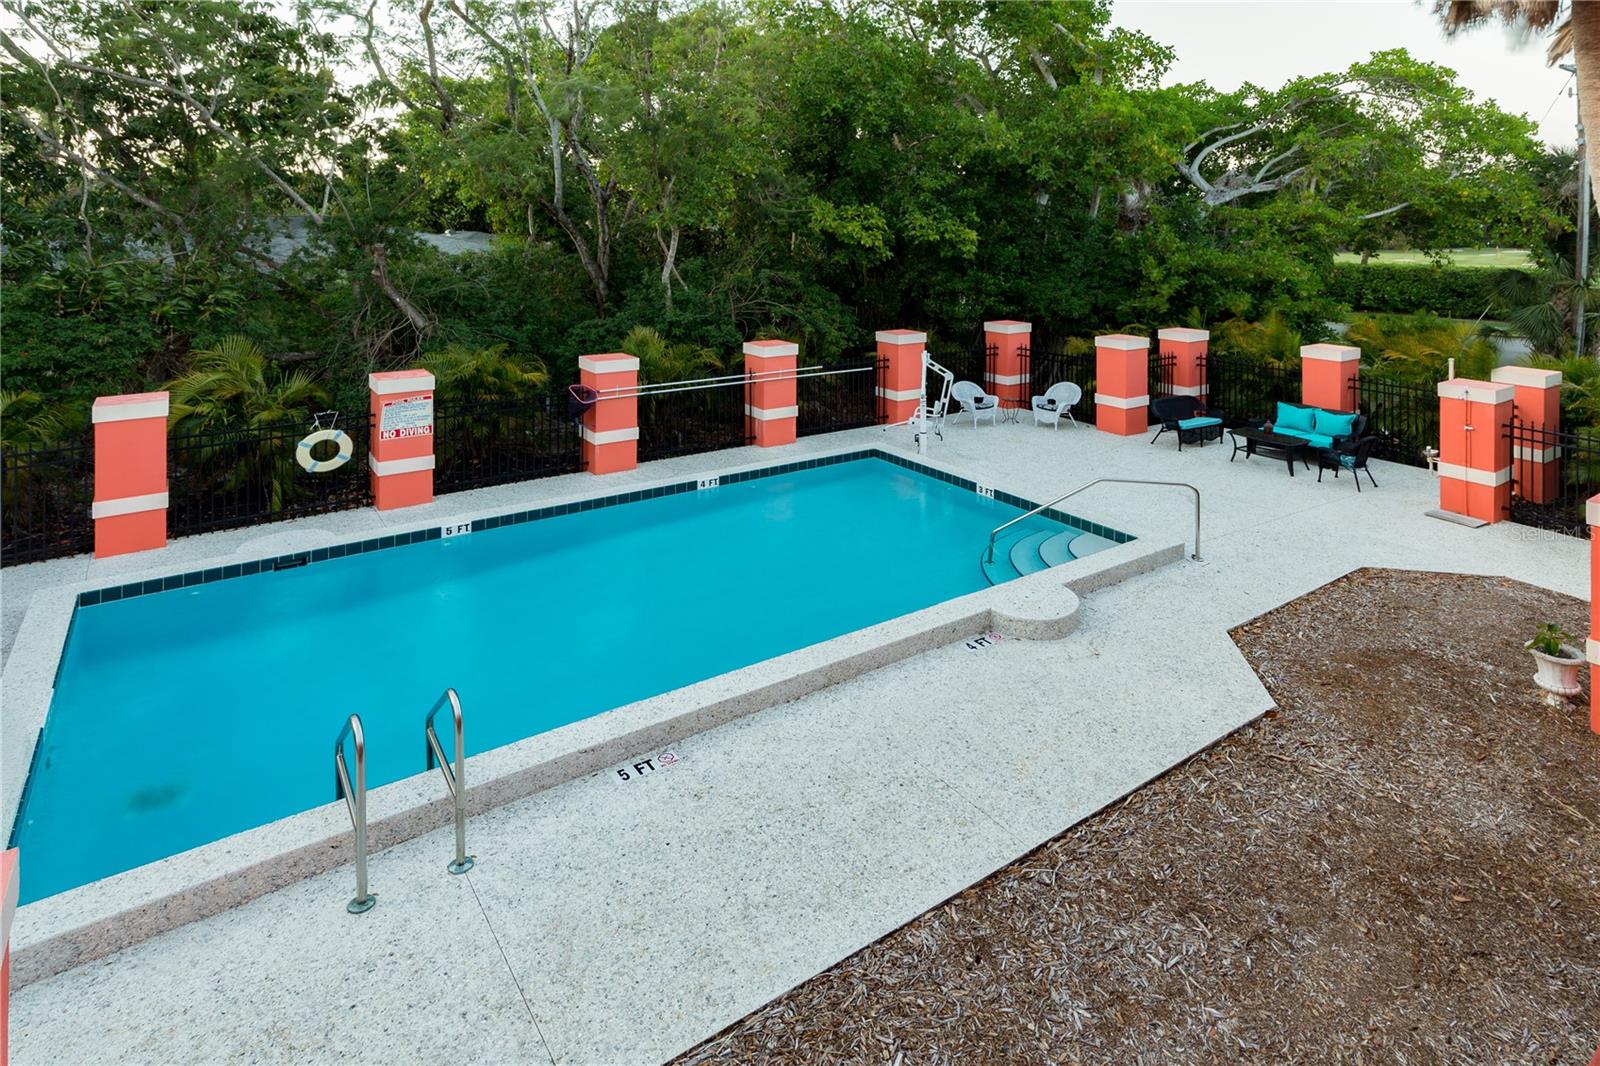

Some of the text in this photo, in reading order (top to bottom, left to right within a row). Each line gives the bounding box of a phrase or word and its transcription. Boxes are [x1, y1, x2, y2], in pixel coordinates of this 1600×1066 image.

[383, 426, 430, 439] NO DIVING
[978, 485, 993, 497] 3 FT
[446, 523, 470, 535] 5 FT
[974, 637, 992, 647] FT
[617, 768, 630, 780] 5
[633, 759, 655, 775] FT
